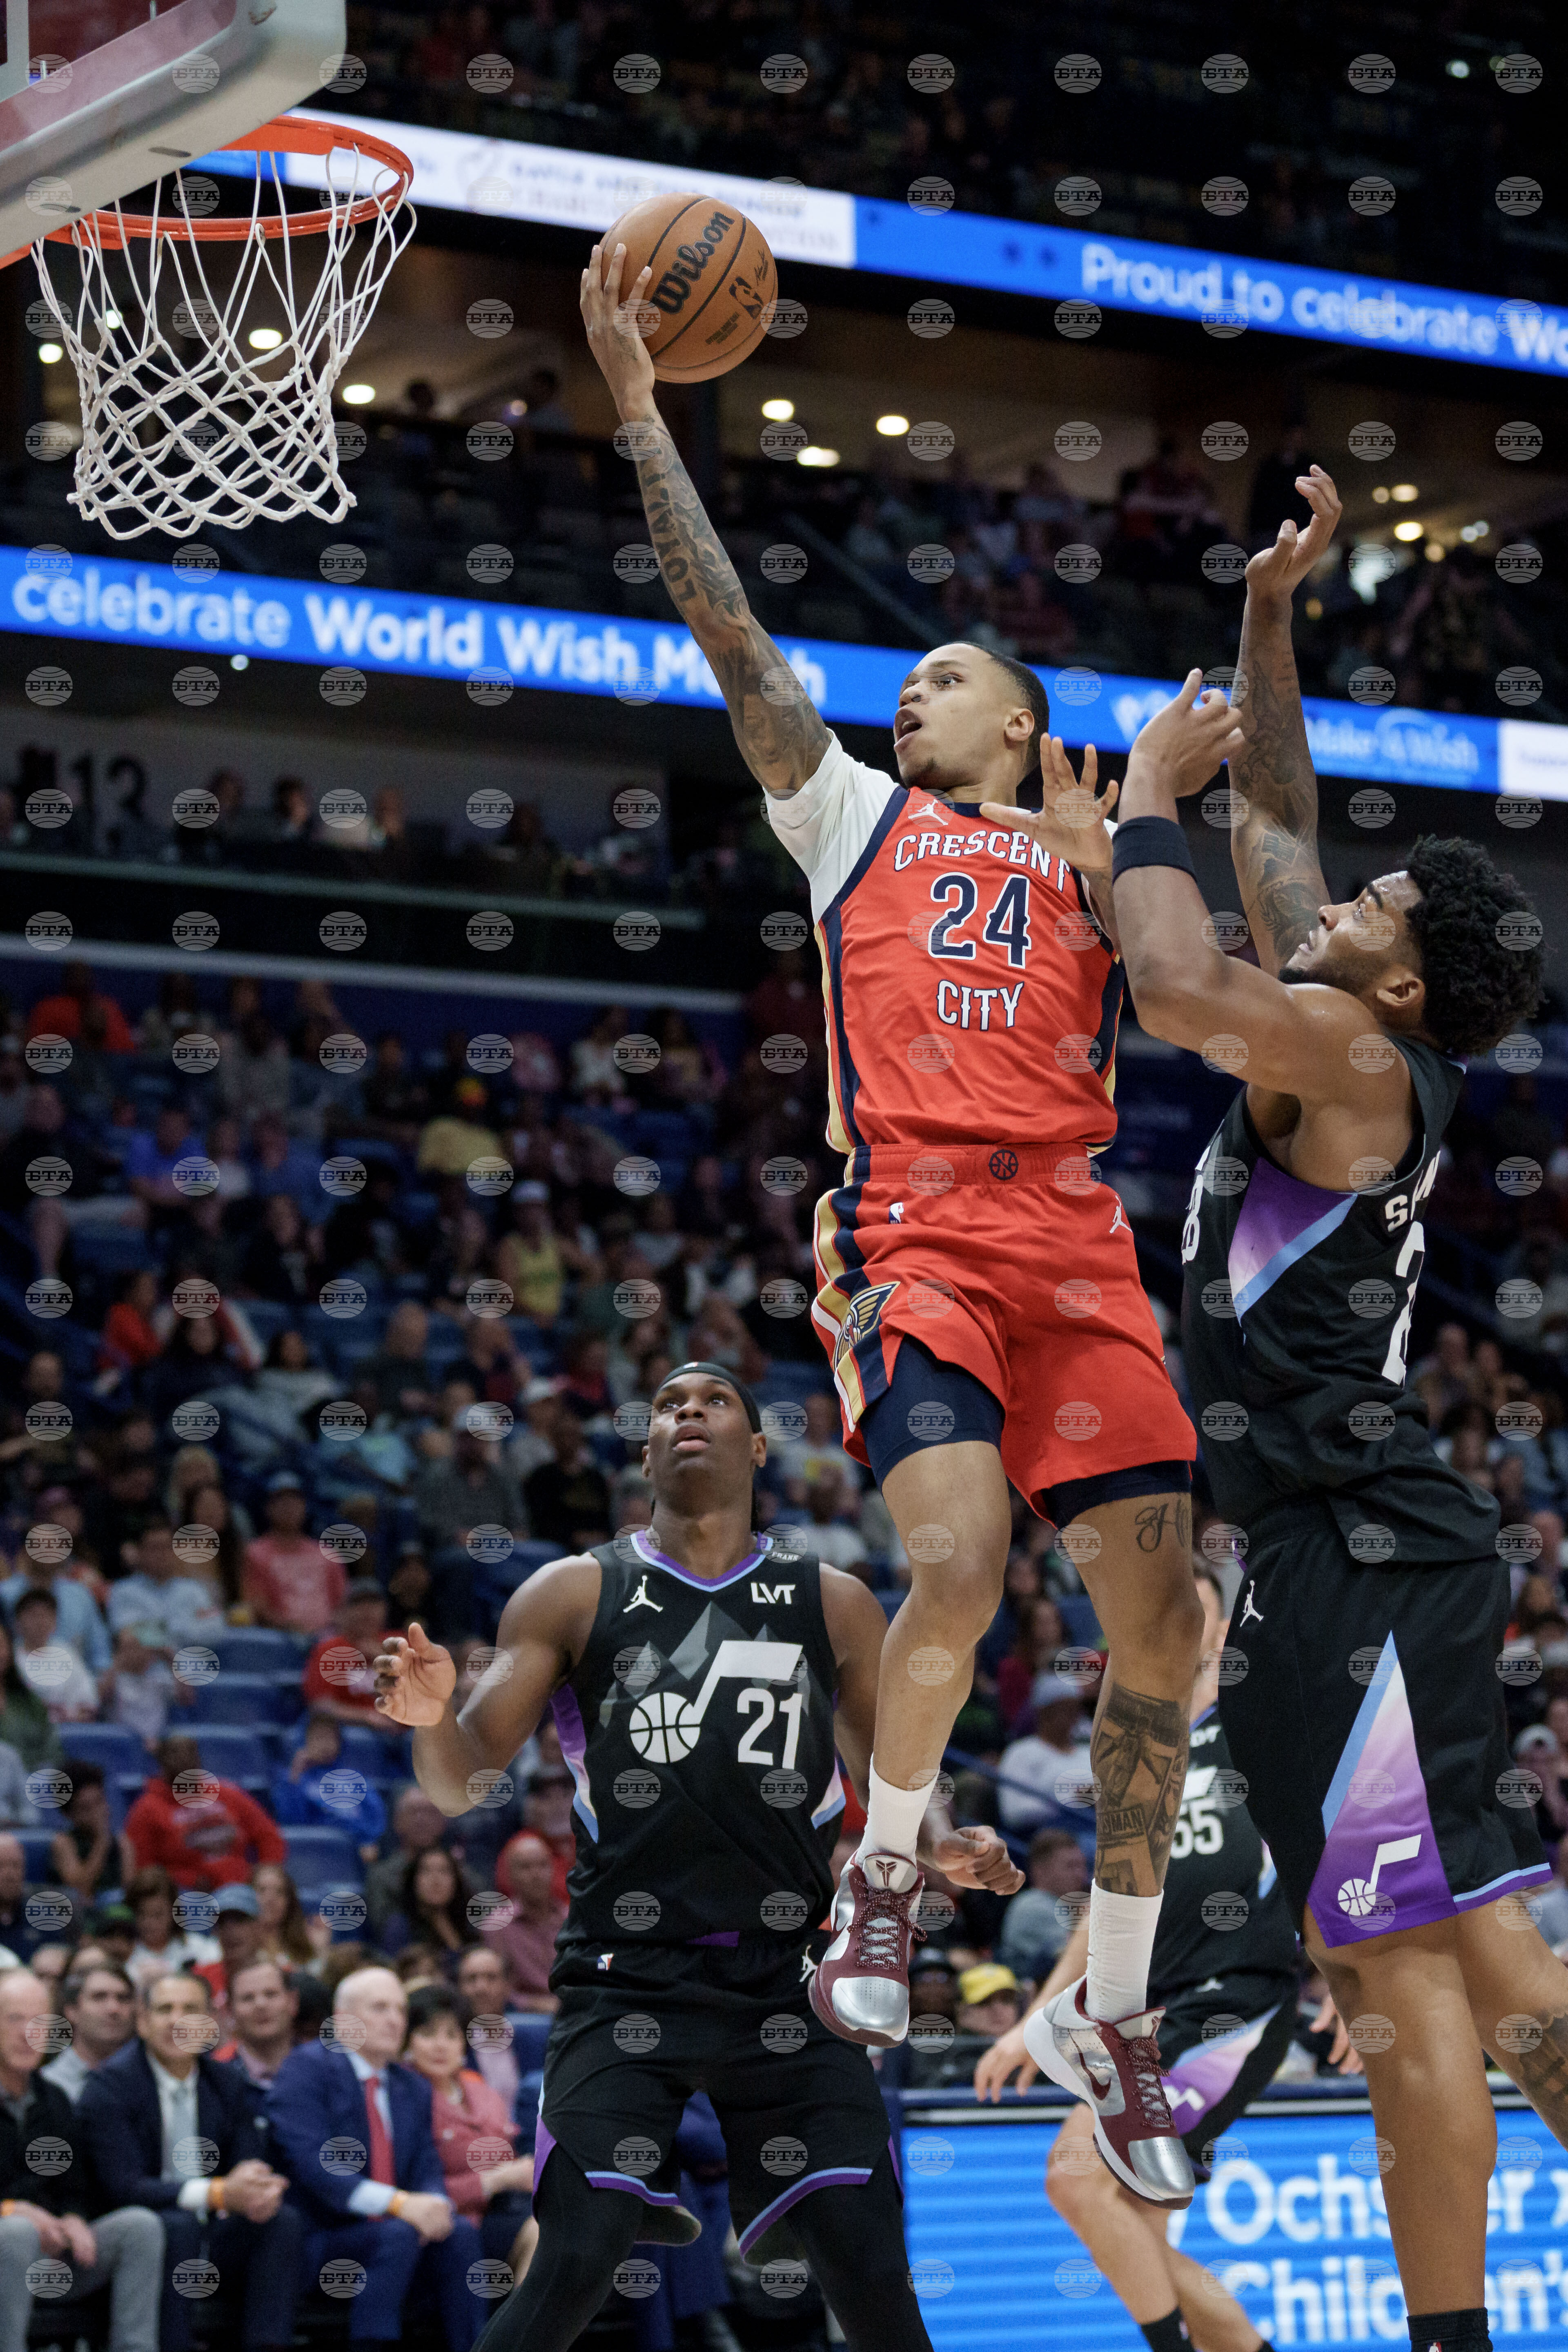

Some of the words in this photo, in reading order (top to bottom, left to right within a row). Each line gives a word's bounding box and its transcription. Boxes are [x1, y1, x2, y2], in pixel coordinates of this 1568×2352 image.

[650, 211, 735, 315] Wilson
[1082, 243, 1223, 315] Proud
[1232, 270, 1285, 323] to
[1291, 285, 1499, 357] celebrate
[11, 566, 292, 649] celebrate
[304, 593, 485, 669] World
[496, 615, 641, 685] Wish
[928, 871, 1032, 970] 24
[936, 979, 1025, 1031] CITY
[751, 1582, 796, 1605] LVT
[736, 1686, 803, 1771] 21
[1170, 1797, 1224, 1859] 55
